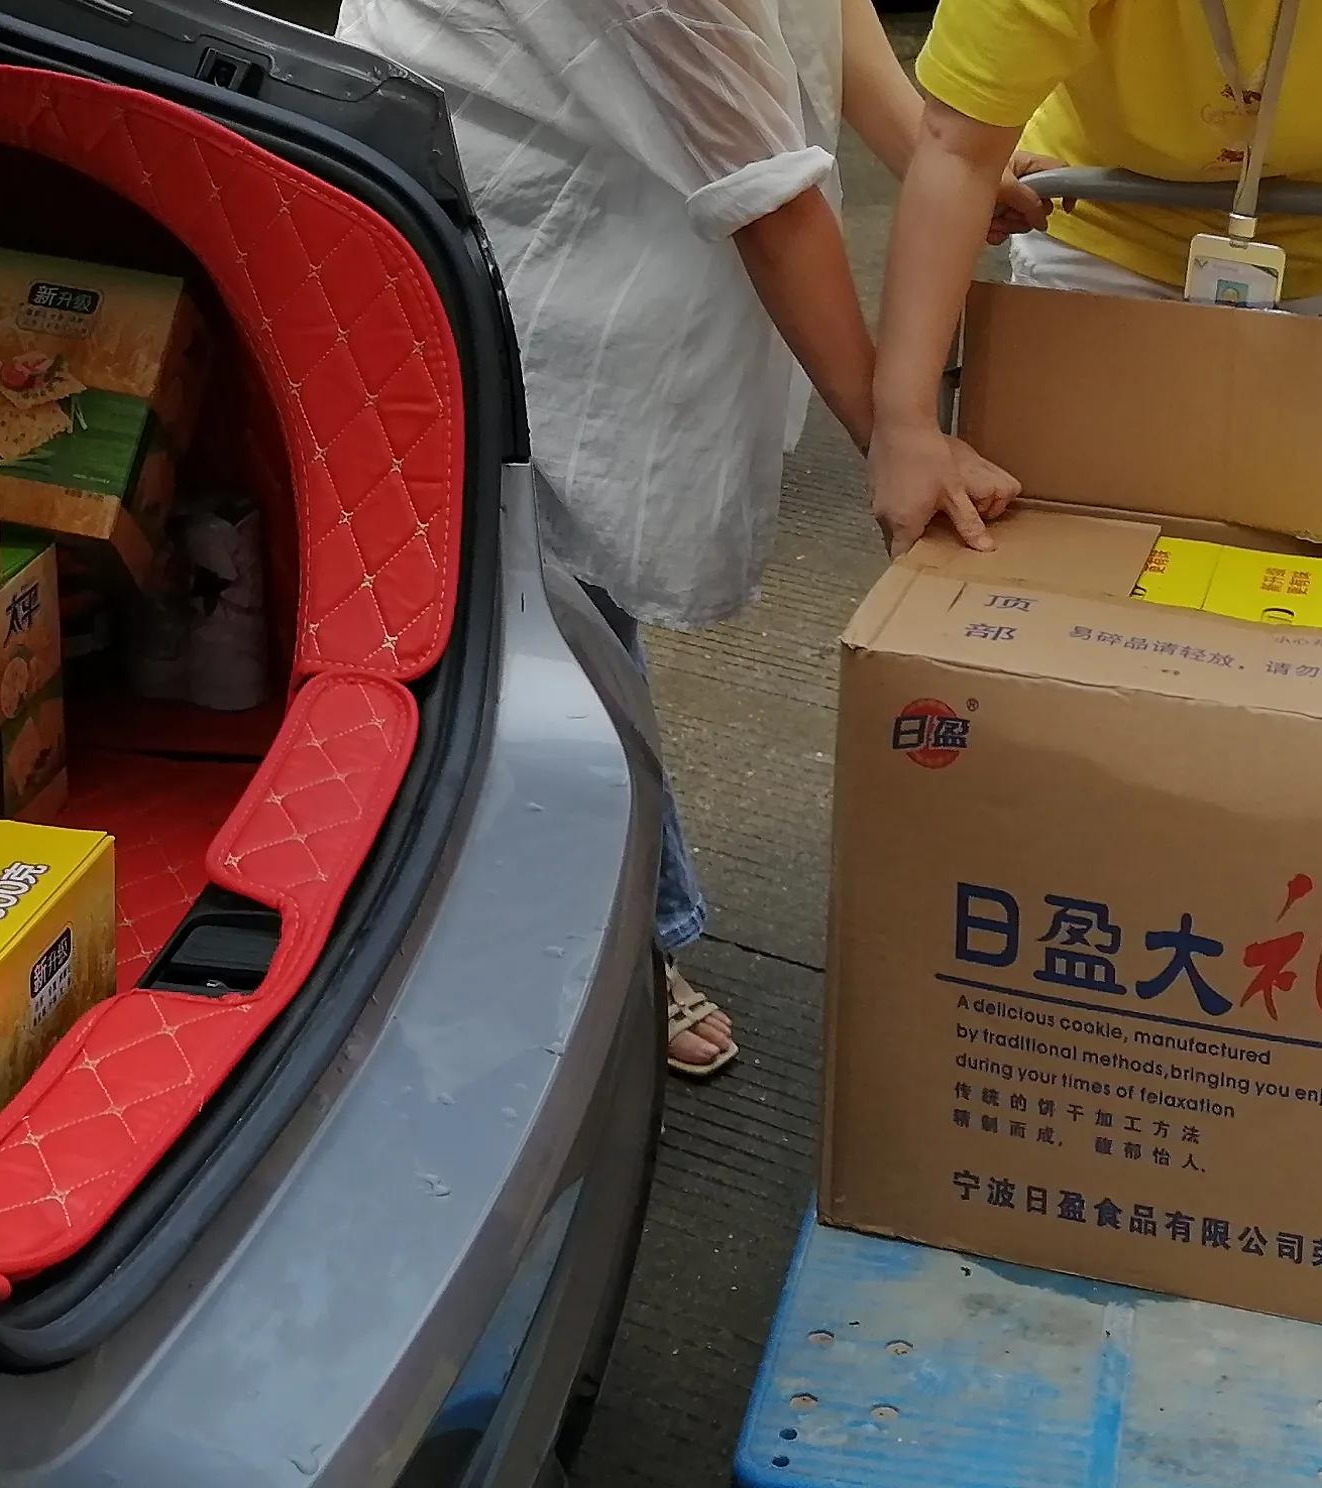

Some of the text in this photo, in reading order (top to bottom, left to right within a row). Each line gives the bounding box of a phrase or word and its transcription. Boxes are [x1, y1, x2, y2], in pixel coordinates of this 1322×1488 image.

[33, 285, 93, 314] 新升级
[5, 580, 41, 646] 太平
[891, 712, 970, 753] 日盈
[32, 932, 72, 994] 新升级
[956, 1023, 978, 1043] by
[982, 1027, 1078, 1061] traditional
[1255, 1078, 1290, 1099] you
[957, 995, 1272, 1066] A delicious cookie, manufactured
[956, 1053, 1014, 1081] during
[1018, 1065, 1058, 1088] your
[1061, 1070, 1112, 1097] times
[1115, 1083, 1135, 1100] of
[953, 1080, 1201, 1146] 传统的饼干加工方法
